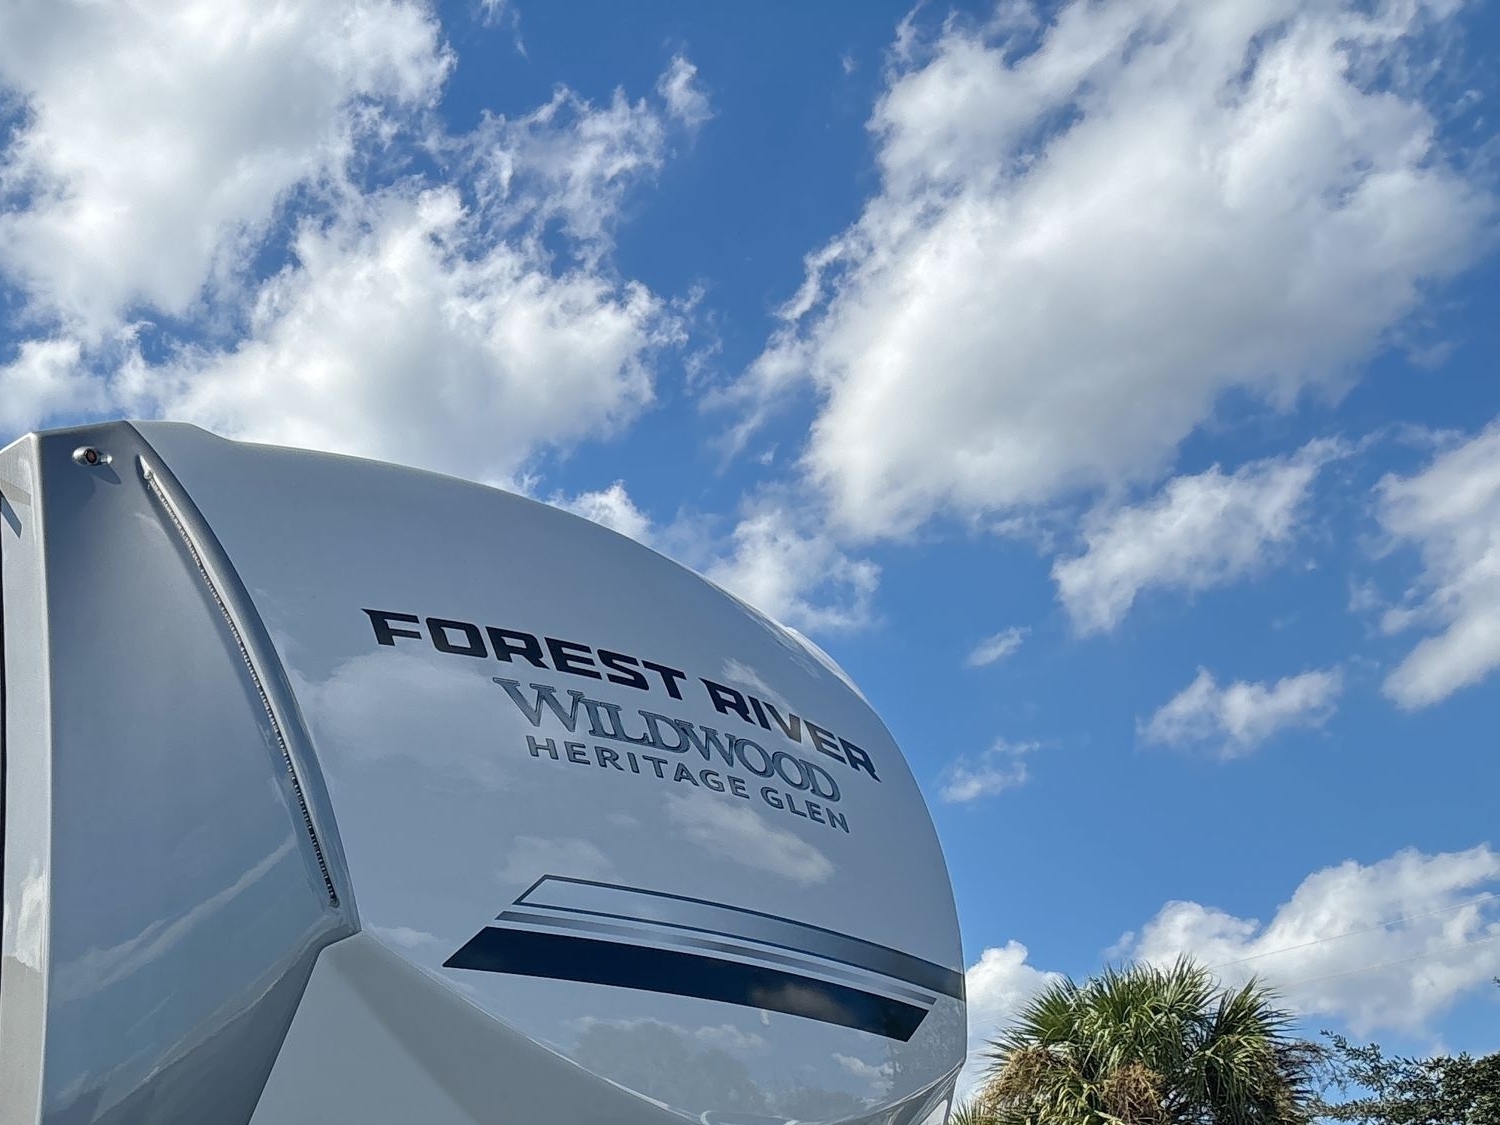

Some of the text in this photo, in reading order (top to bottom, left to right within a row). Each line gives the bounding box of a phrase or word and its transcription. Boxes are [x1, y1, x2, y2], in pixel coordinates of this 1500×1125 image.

[361, 608, 882, 782] FOREST RIVER
[492, 677, 842, 803] WILDWOOD
[525, 735, 850, 833] HERITAGE GLEN
